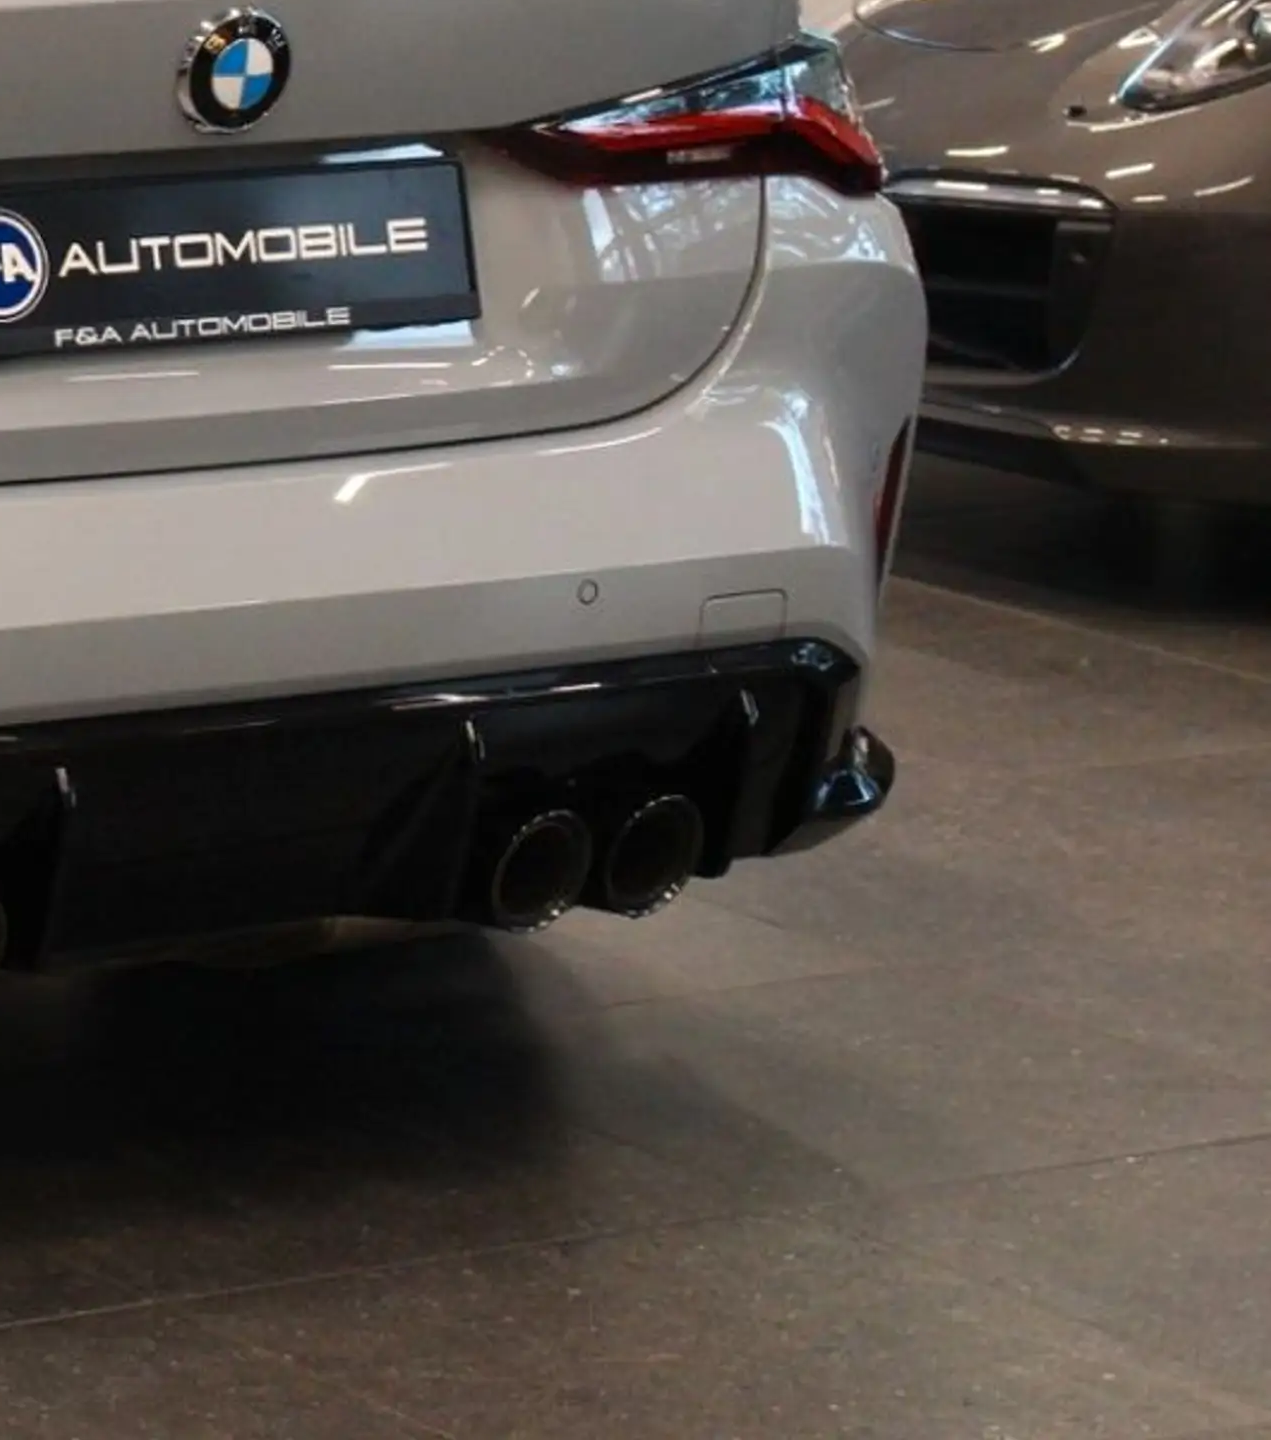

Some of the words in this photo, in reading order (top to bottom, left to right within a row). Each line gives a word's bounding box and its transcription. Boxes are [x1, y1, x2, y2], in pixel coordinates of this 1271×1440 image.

[59, 217, 429, 278] AUTOMOBILE
[54, 327, 123, 348] F&A
[130, 307, 351, 341] AUTOMOBILE
